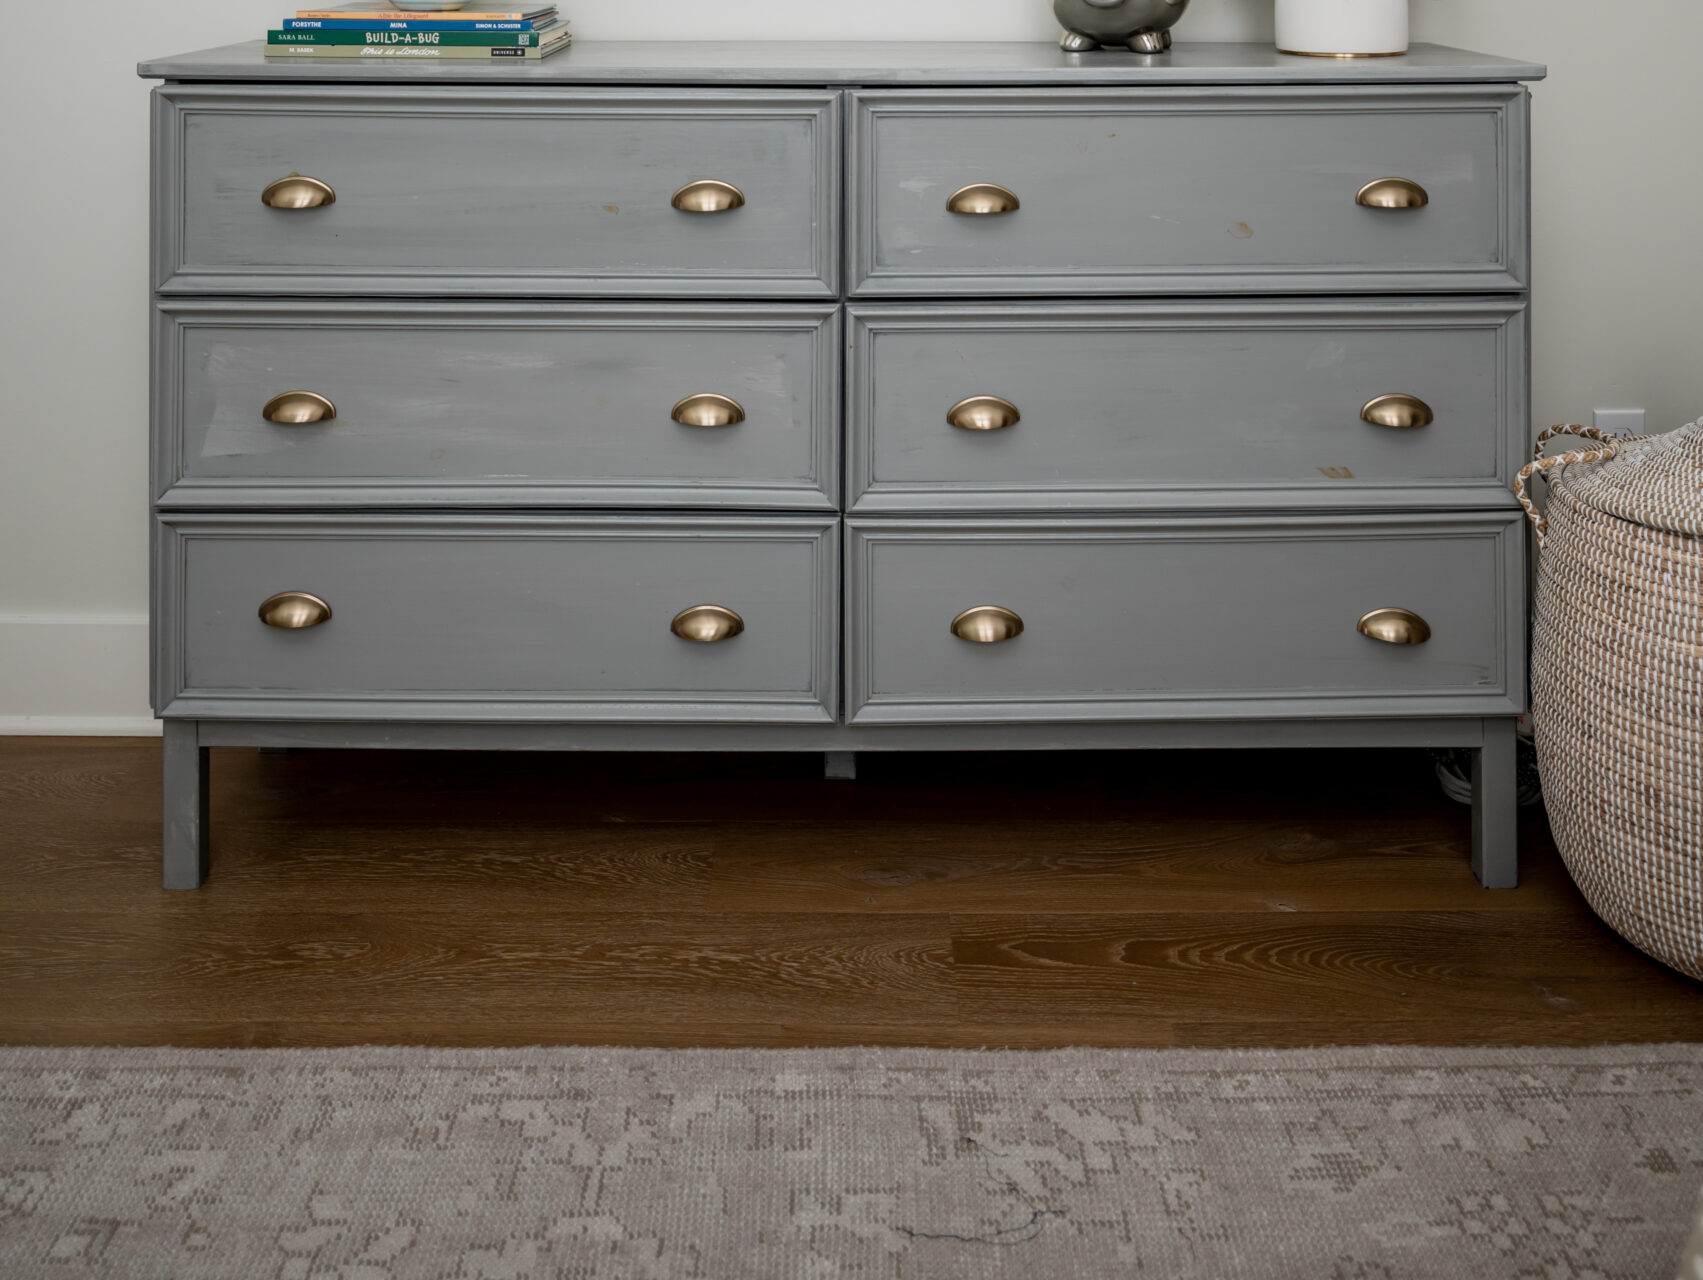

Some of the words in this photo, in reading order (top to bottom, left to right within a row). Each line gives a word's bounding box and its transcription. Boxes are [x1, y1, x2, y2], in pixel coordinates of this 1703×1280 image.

[365, 32, 440, 44] BUILD-A-BUG
[360, 47, 384, 56] This
[396, 47, 440, 56] London
